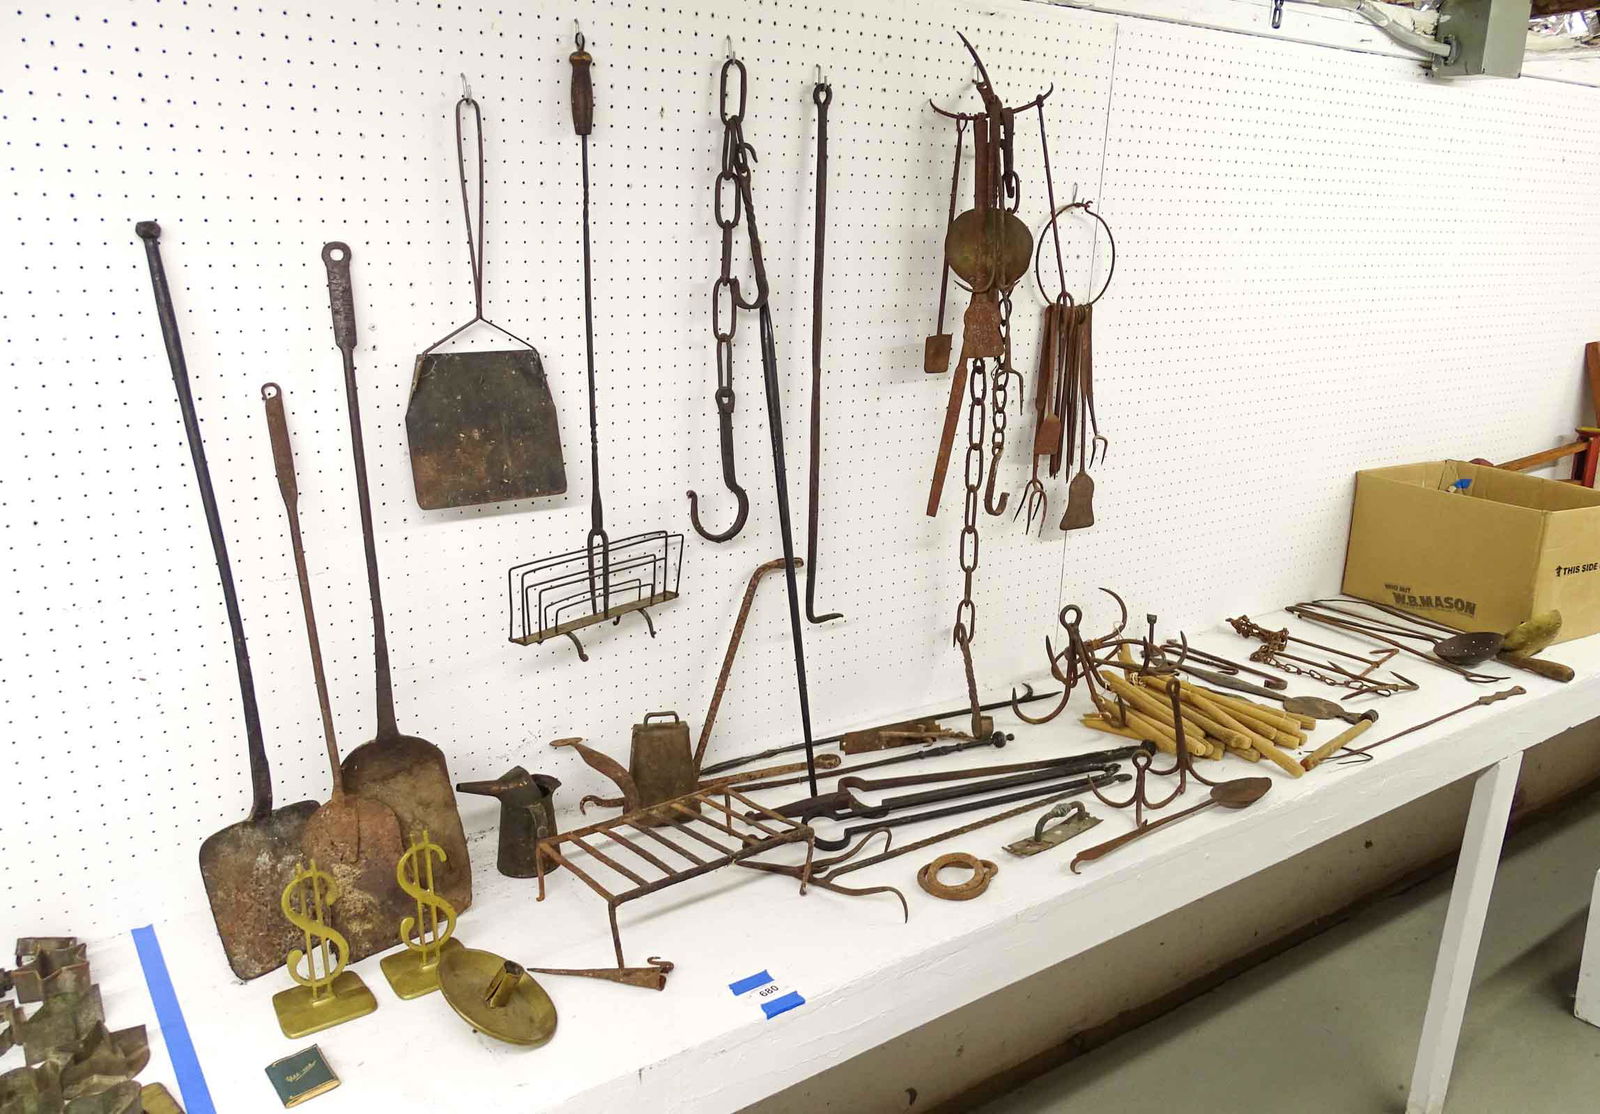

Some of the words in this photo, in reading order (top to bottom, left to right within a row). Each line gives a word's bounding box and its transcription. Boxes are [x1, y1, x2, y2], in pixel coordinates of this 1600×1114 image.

[1563, 565, 1581, 576] THIS
[1581, 562, 1599, 573] SIDE
[759, 985, 779, 997] 680
